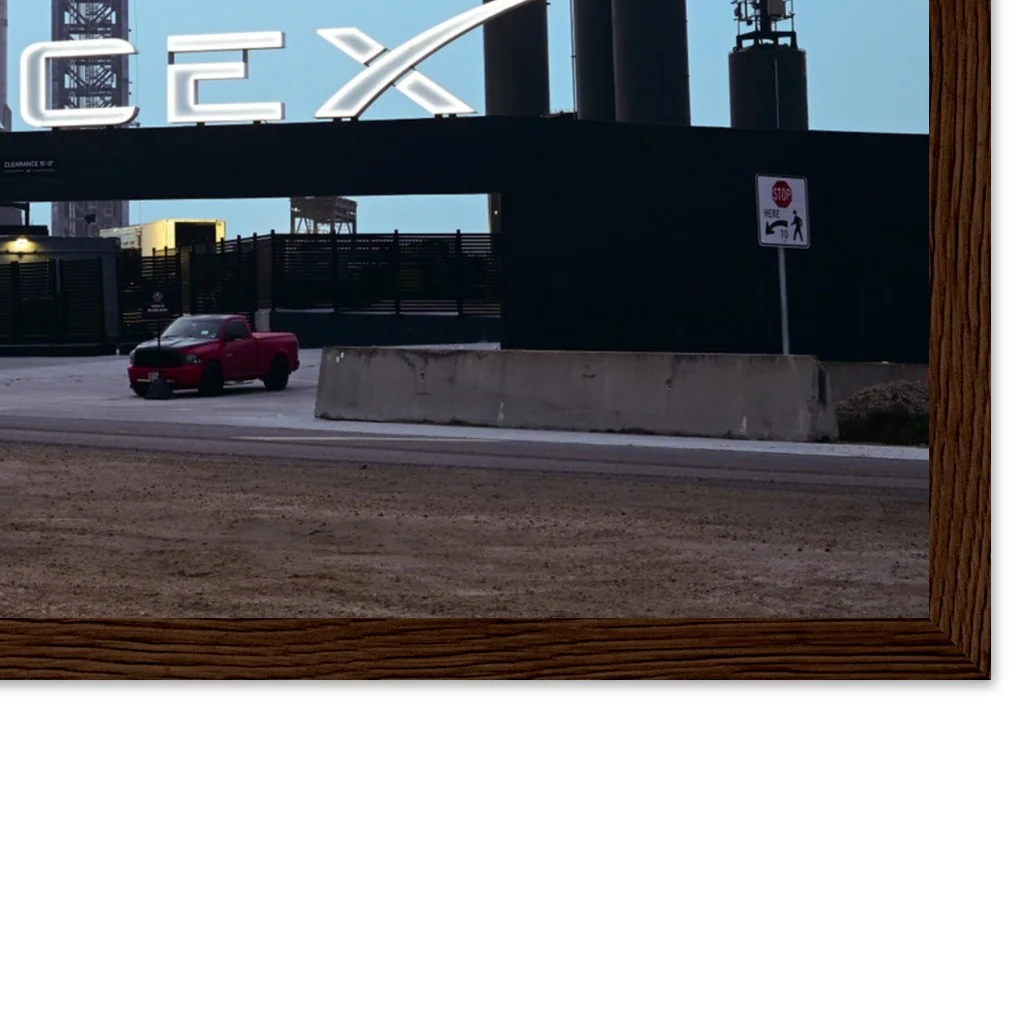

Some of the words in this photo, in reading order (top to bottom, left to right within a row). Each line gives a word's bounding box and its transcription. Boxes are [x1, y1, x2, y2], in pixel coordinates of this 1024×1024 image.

[773, 187, 792, 201] STOP
[764, 209, 780, 218] HERE
[780, 229, 789, 239] TO
